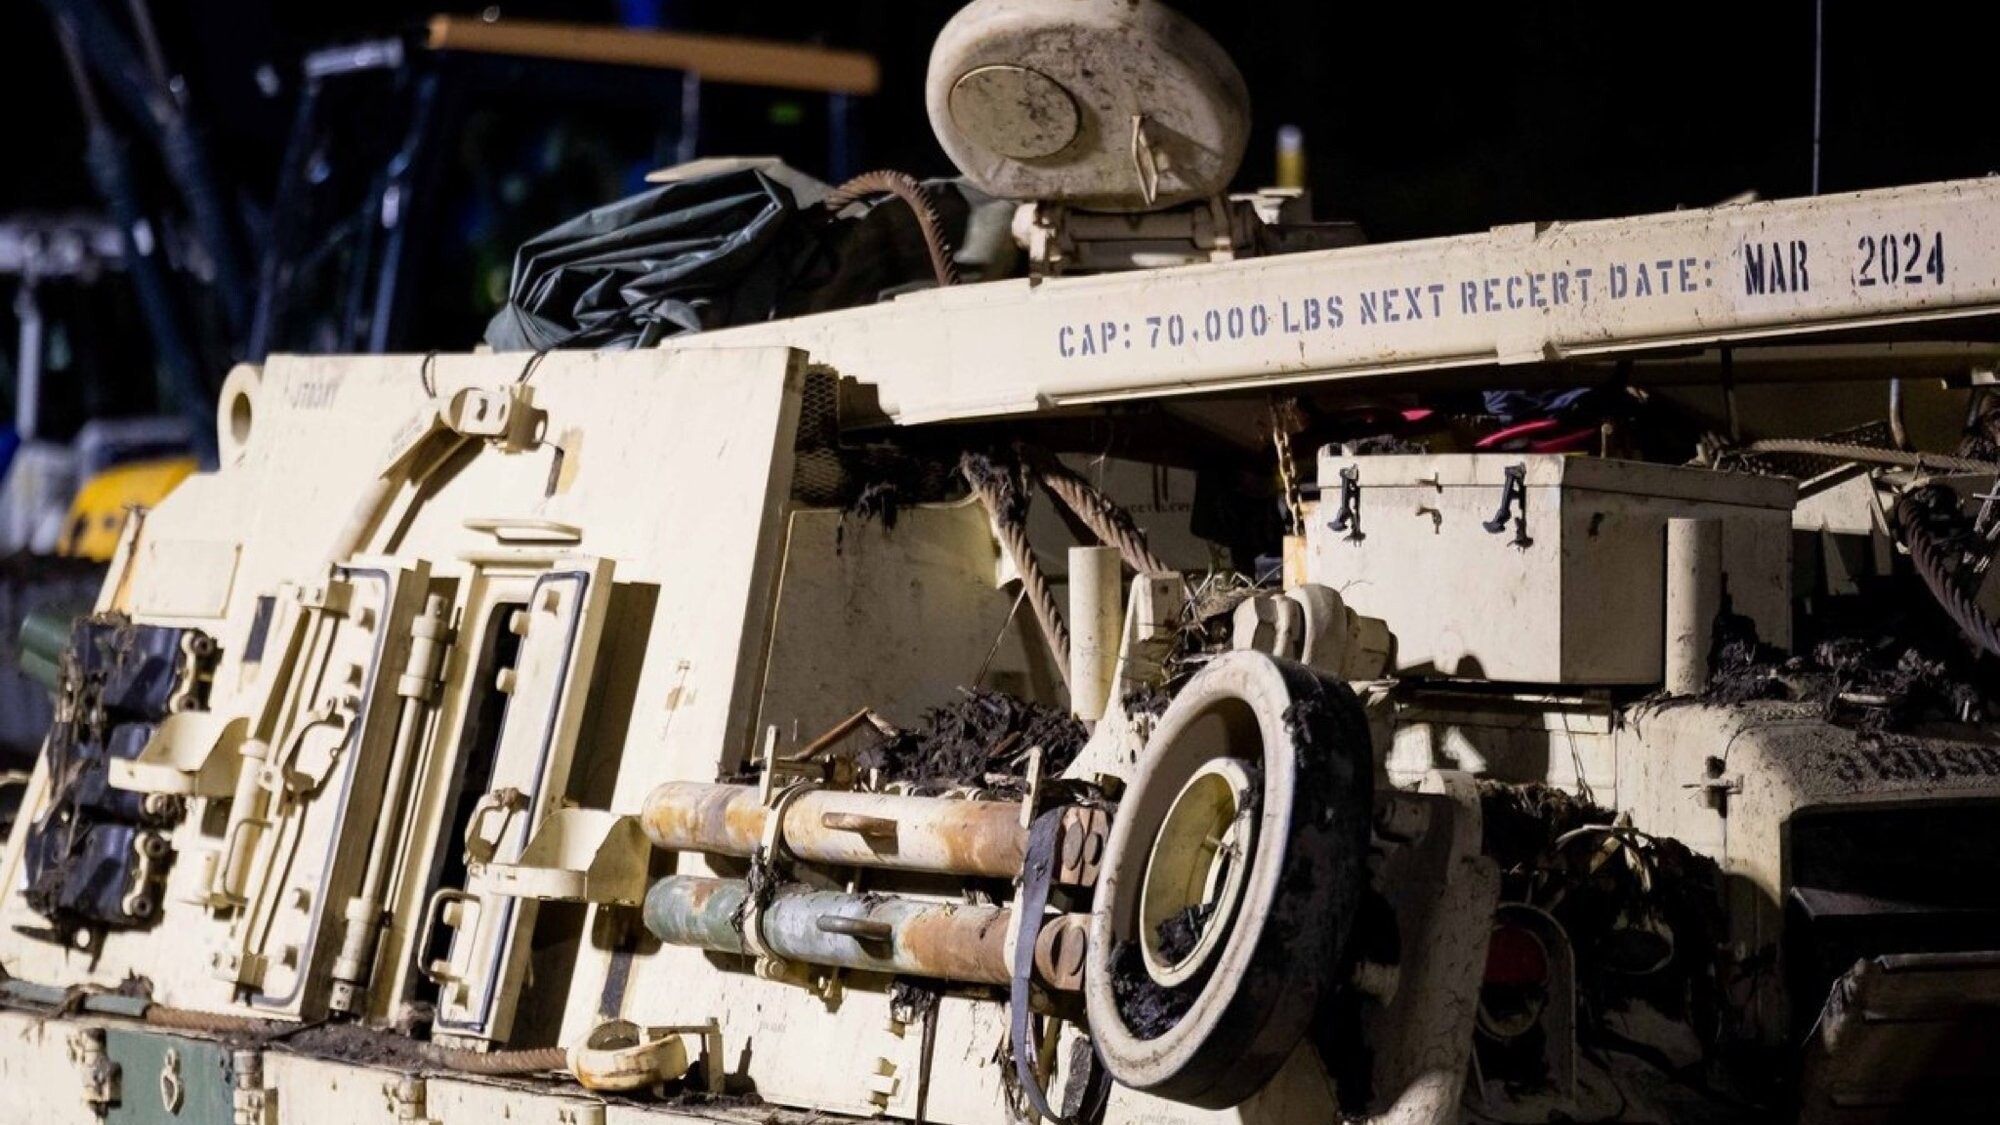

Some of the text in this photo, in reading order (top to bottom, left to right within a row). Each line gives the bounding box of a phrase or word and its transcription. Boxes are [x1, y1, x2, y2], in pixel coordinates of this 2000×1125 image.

[1059, 322, 1131, 358] CAP:
[1282, 296, 1345, 333] LBS
[1359, 284, 1445, 325] NEXT
[1460, 268, 1593, 314] RECERT
[1609, 258, 1712, 300] DATE:
[1744, 240, 1810, 295] MAR
[1857, 231, 1945, 287] 2024
